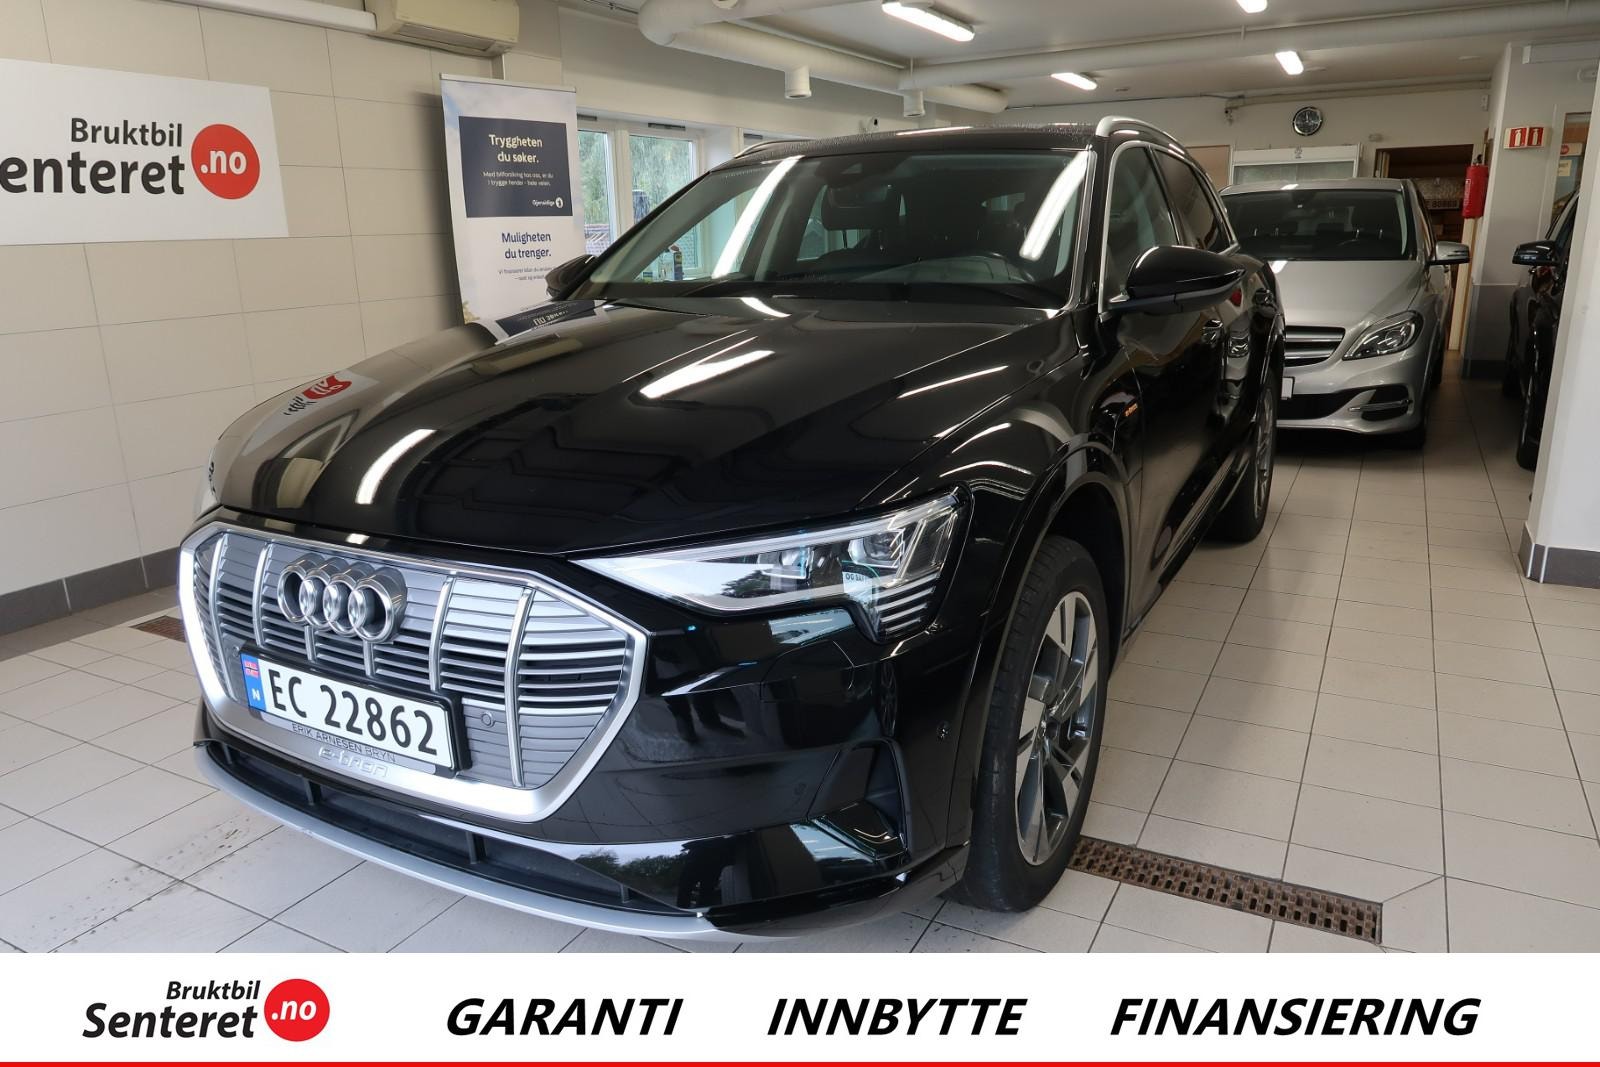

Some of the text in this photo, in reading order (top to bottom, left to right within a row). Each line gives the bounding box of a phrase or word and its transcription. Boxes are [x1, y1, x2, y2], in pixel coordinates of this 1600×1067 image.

[71, 117, 183, 147] Bruktbil
[489, 134, 543, 149] Tryggheten
[200, 149, 247, 175] .no
[497, 151, 540, 164] du søker.
[501, 231, 552, 245] Muligheten
[504, 247, 552, 260] du trenger.
[268, 668, 438, 756] EC 22862
[291, 722, 397, 763] ERIK ARNESEN BRYN
